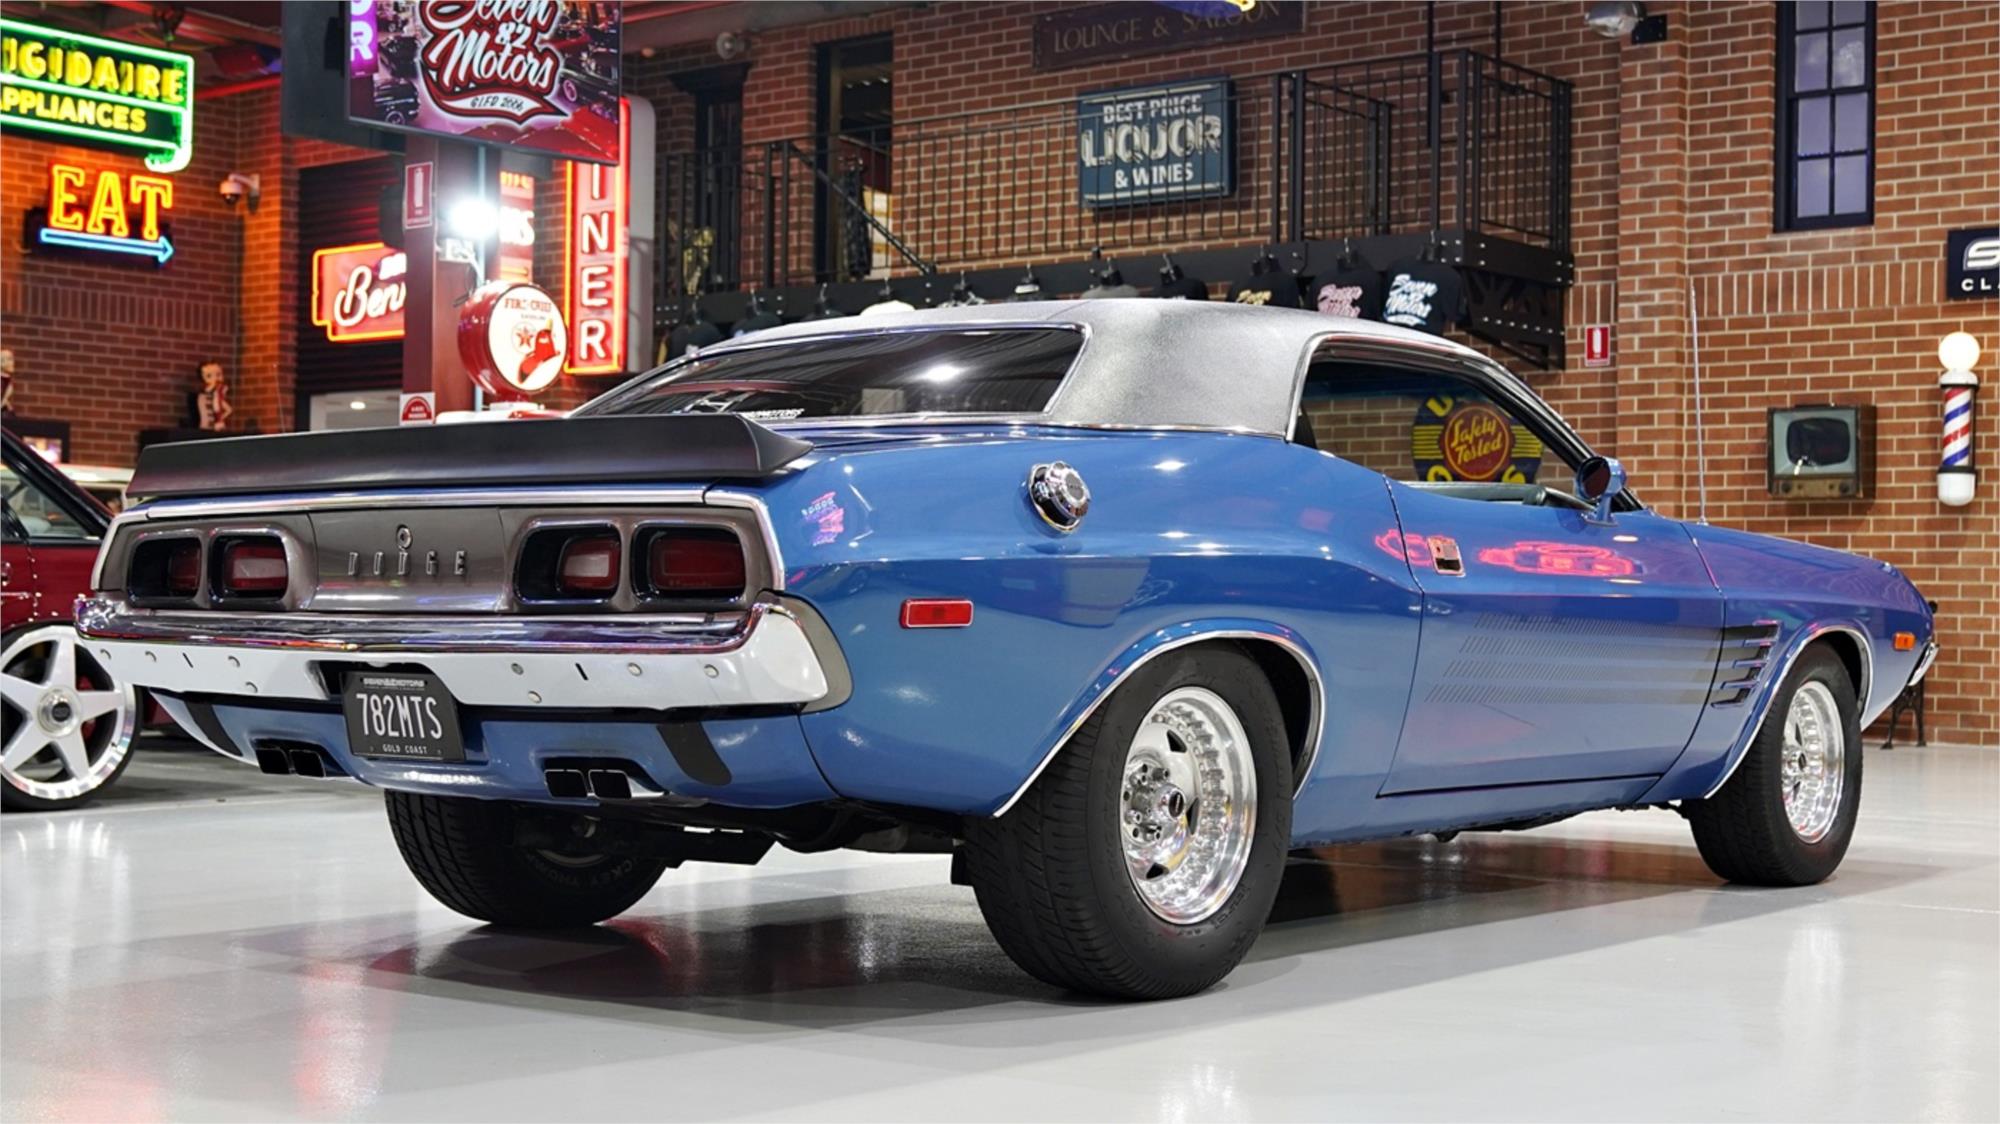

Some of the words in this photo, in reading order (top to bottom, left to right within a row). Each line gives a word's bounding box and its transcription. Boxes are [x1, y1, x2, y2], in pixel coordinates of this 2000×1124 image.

[495, 21, 531, 48] 82
[1055, 17, 1142, 52] LOUNGE
[1152, 16, 1171, 38] &
[430, 28, 554, 88] Motors
[1103, 101, 1146, 124] BEST
[1151, 94, 1203, 118] PRICE
[1081, 115, 1222, 168] LIQUOR
[1115, 169, 1129, 189] &
[1132, 163, 1194, 186] WINES
[50, 164, 174, 241] EAT
[1961, 277, 2000, 291] CL
[1451, 416, 1497, 448] Safety
[1455, 431, 1502, 464] Tested
[348, 550, 465, 575] DODGE
[356, 693, 443, 739] 782MTS
[382, 743, 401, 753] GOLD
[404, 744, 428, 755] COAST
